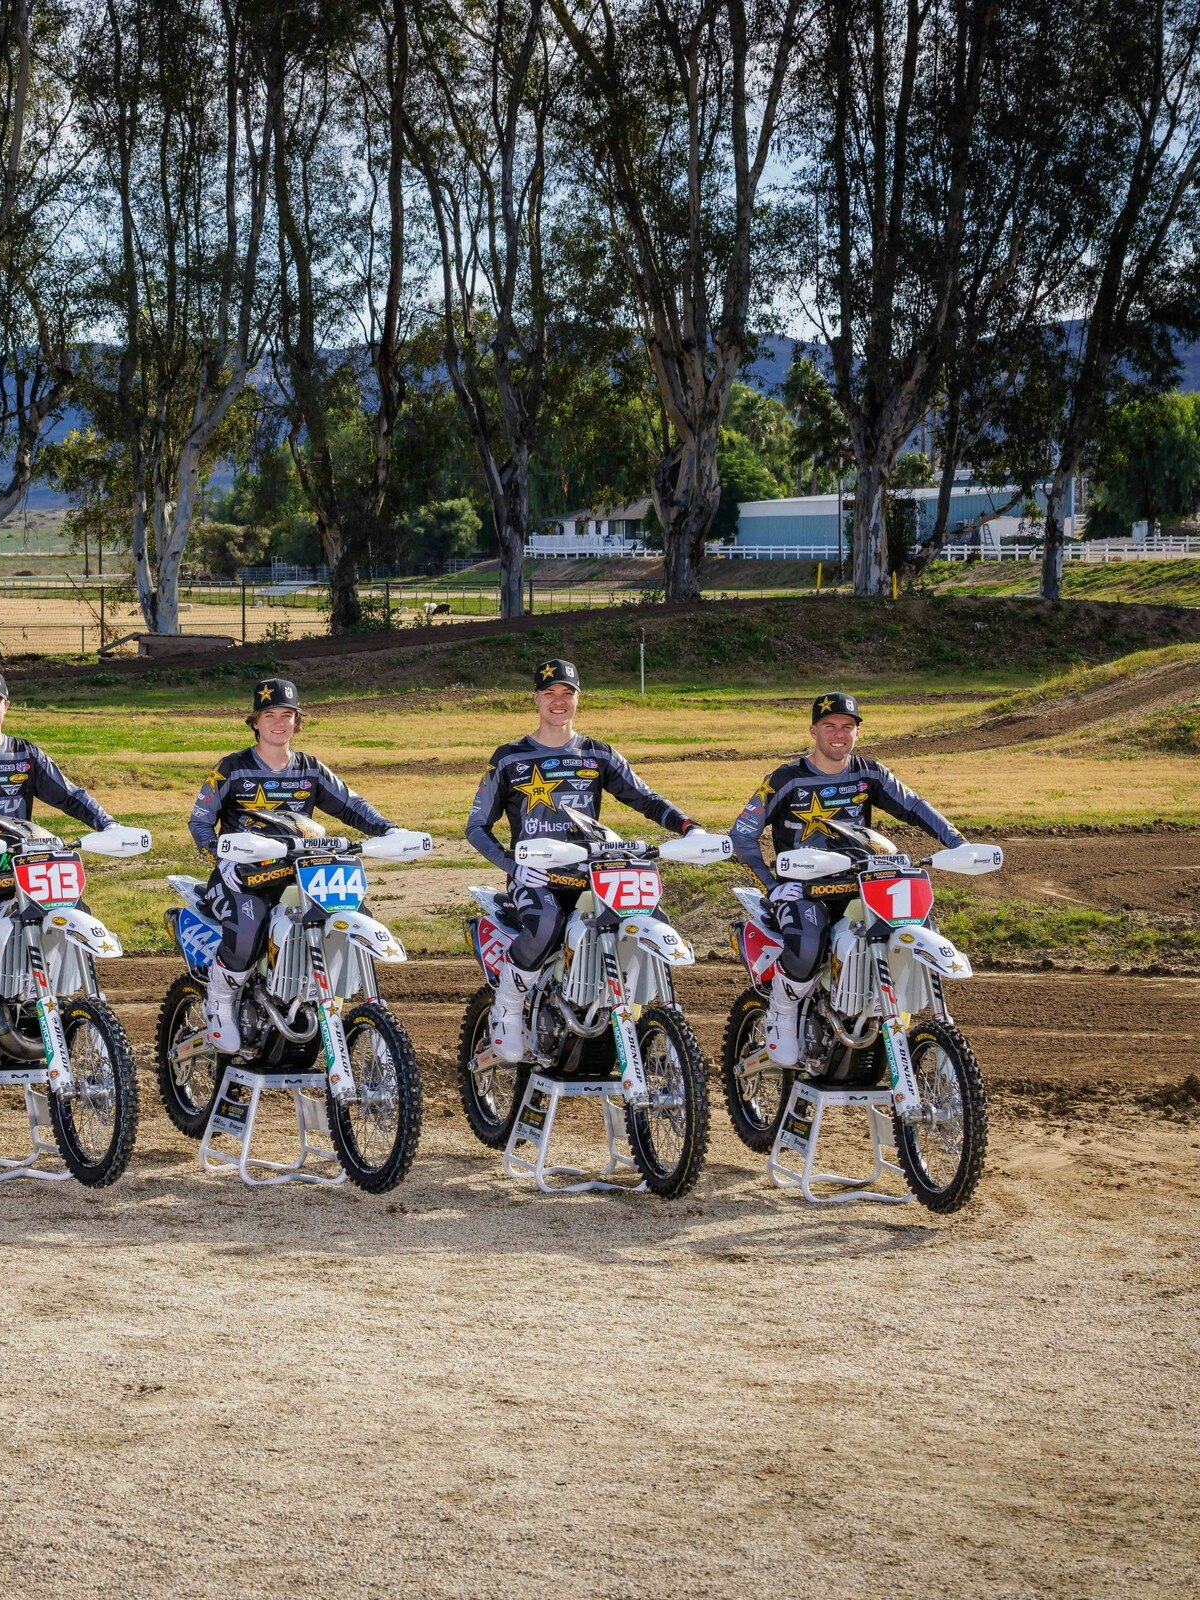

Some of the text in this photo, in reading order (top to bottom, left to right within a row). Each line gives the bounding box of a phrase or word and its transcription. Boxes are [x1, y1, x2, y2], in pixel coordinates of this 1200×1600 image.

[559, 794, 593, 809] FLY
[303, 837, 340, 849] PROTAPER
[539, 820, 576, 833] Husqv
[600, 841, 636, 850] PROTAPER
[28, 863, 80, 901] 513
[247, 866, 294, 886] ROCKSTA
[308, 867, 365, 902] 444
[549, 873, 588, 888] CKSTAR
[599, 871, 660, 907] 739
[811, 884, 859, 895] ROCKSTA
[886, 879, 911, 918] 1
[752, 945, 784, 976] 1
[39, 1016, 54, 1054] MOTOREX
[54, 1025, 70, 1072] DUNLOP
[320, 1020, 335, 1058] MOTOREX
[614, 1026, 627, 1065] MOTOREX
[336, 1031, 351, 1077] DUNLOP
[628, 1036, 643, 1083] DUNLOP
[885, 1038, 899, 1077] MOTOREX
[900, 1049, 915, 1096] DUNLOP
